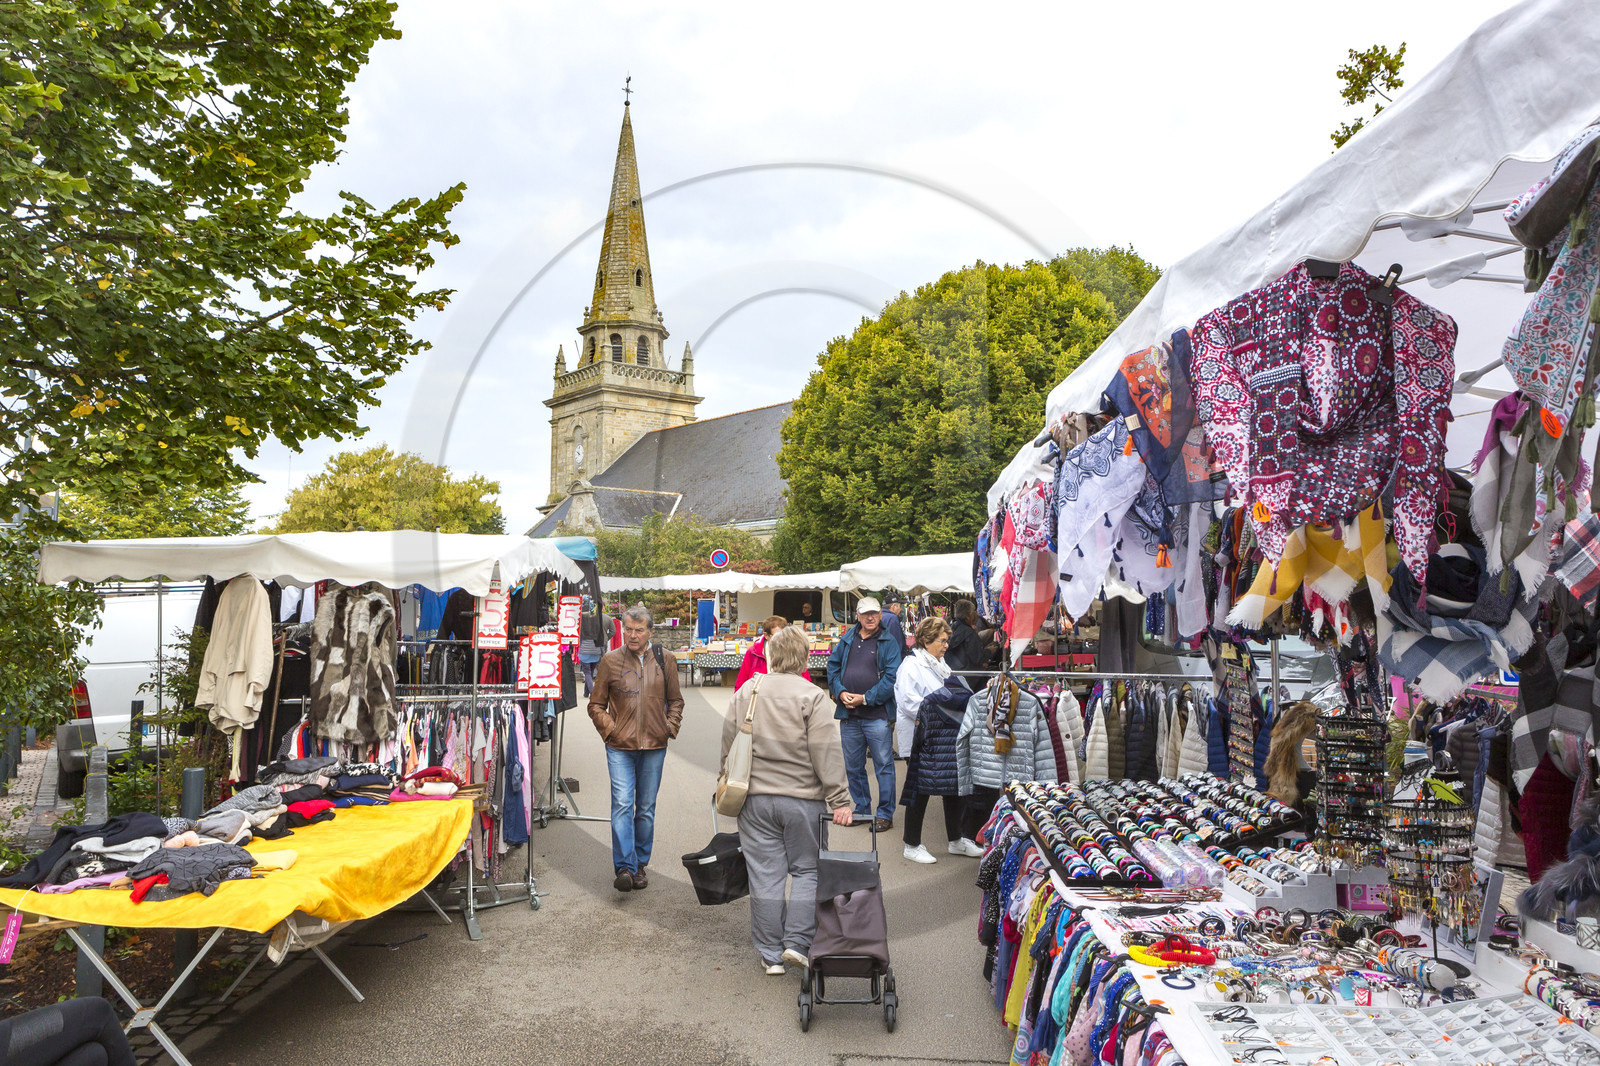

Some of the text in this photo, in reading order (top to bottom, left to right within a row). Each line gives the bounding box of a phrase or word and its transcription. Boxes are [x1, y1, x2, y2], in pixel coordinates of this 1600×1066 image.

[1257, 504, 1269, 518] 10
[483, 599, 503, 627] 5
[563, 609, 577, 628] 5
[536, 651, 556, 679] 5
